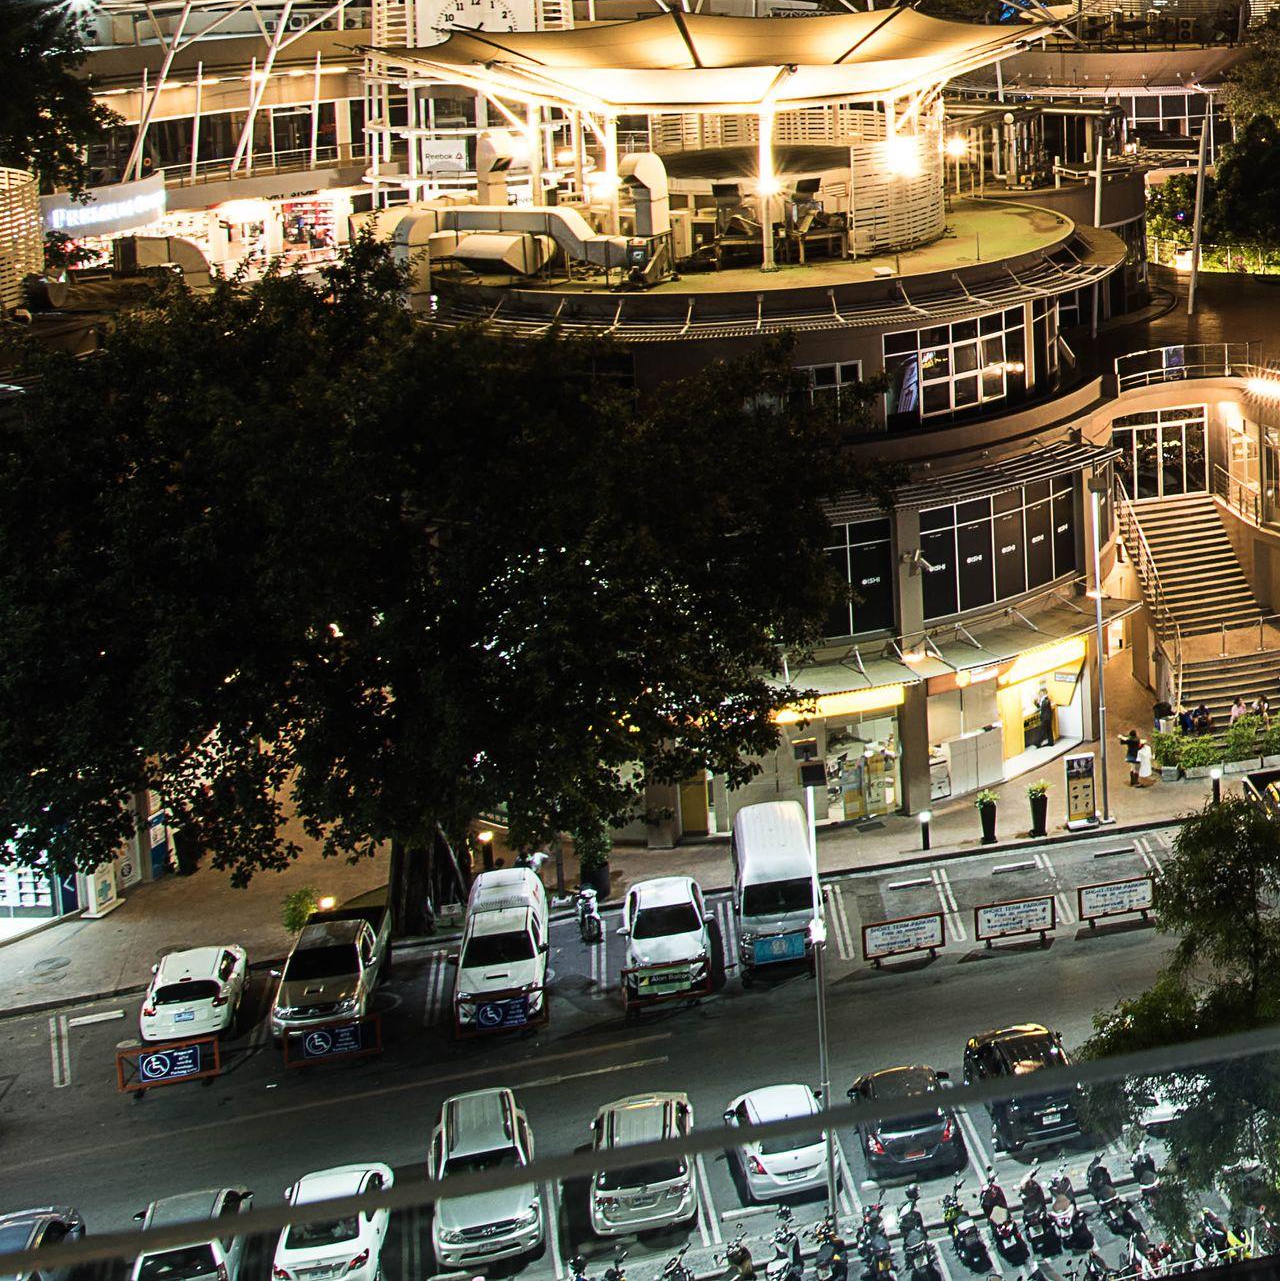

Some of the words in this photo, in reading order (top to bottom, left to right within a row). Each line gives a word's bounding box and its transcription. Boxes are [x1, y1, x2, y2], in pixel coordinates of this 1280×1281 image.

[456, 3, 464, 11] 11
[444, 14, 454, 22] 10
[502, 11, 507, 19] 2
